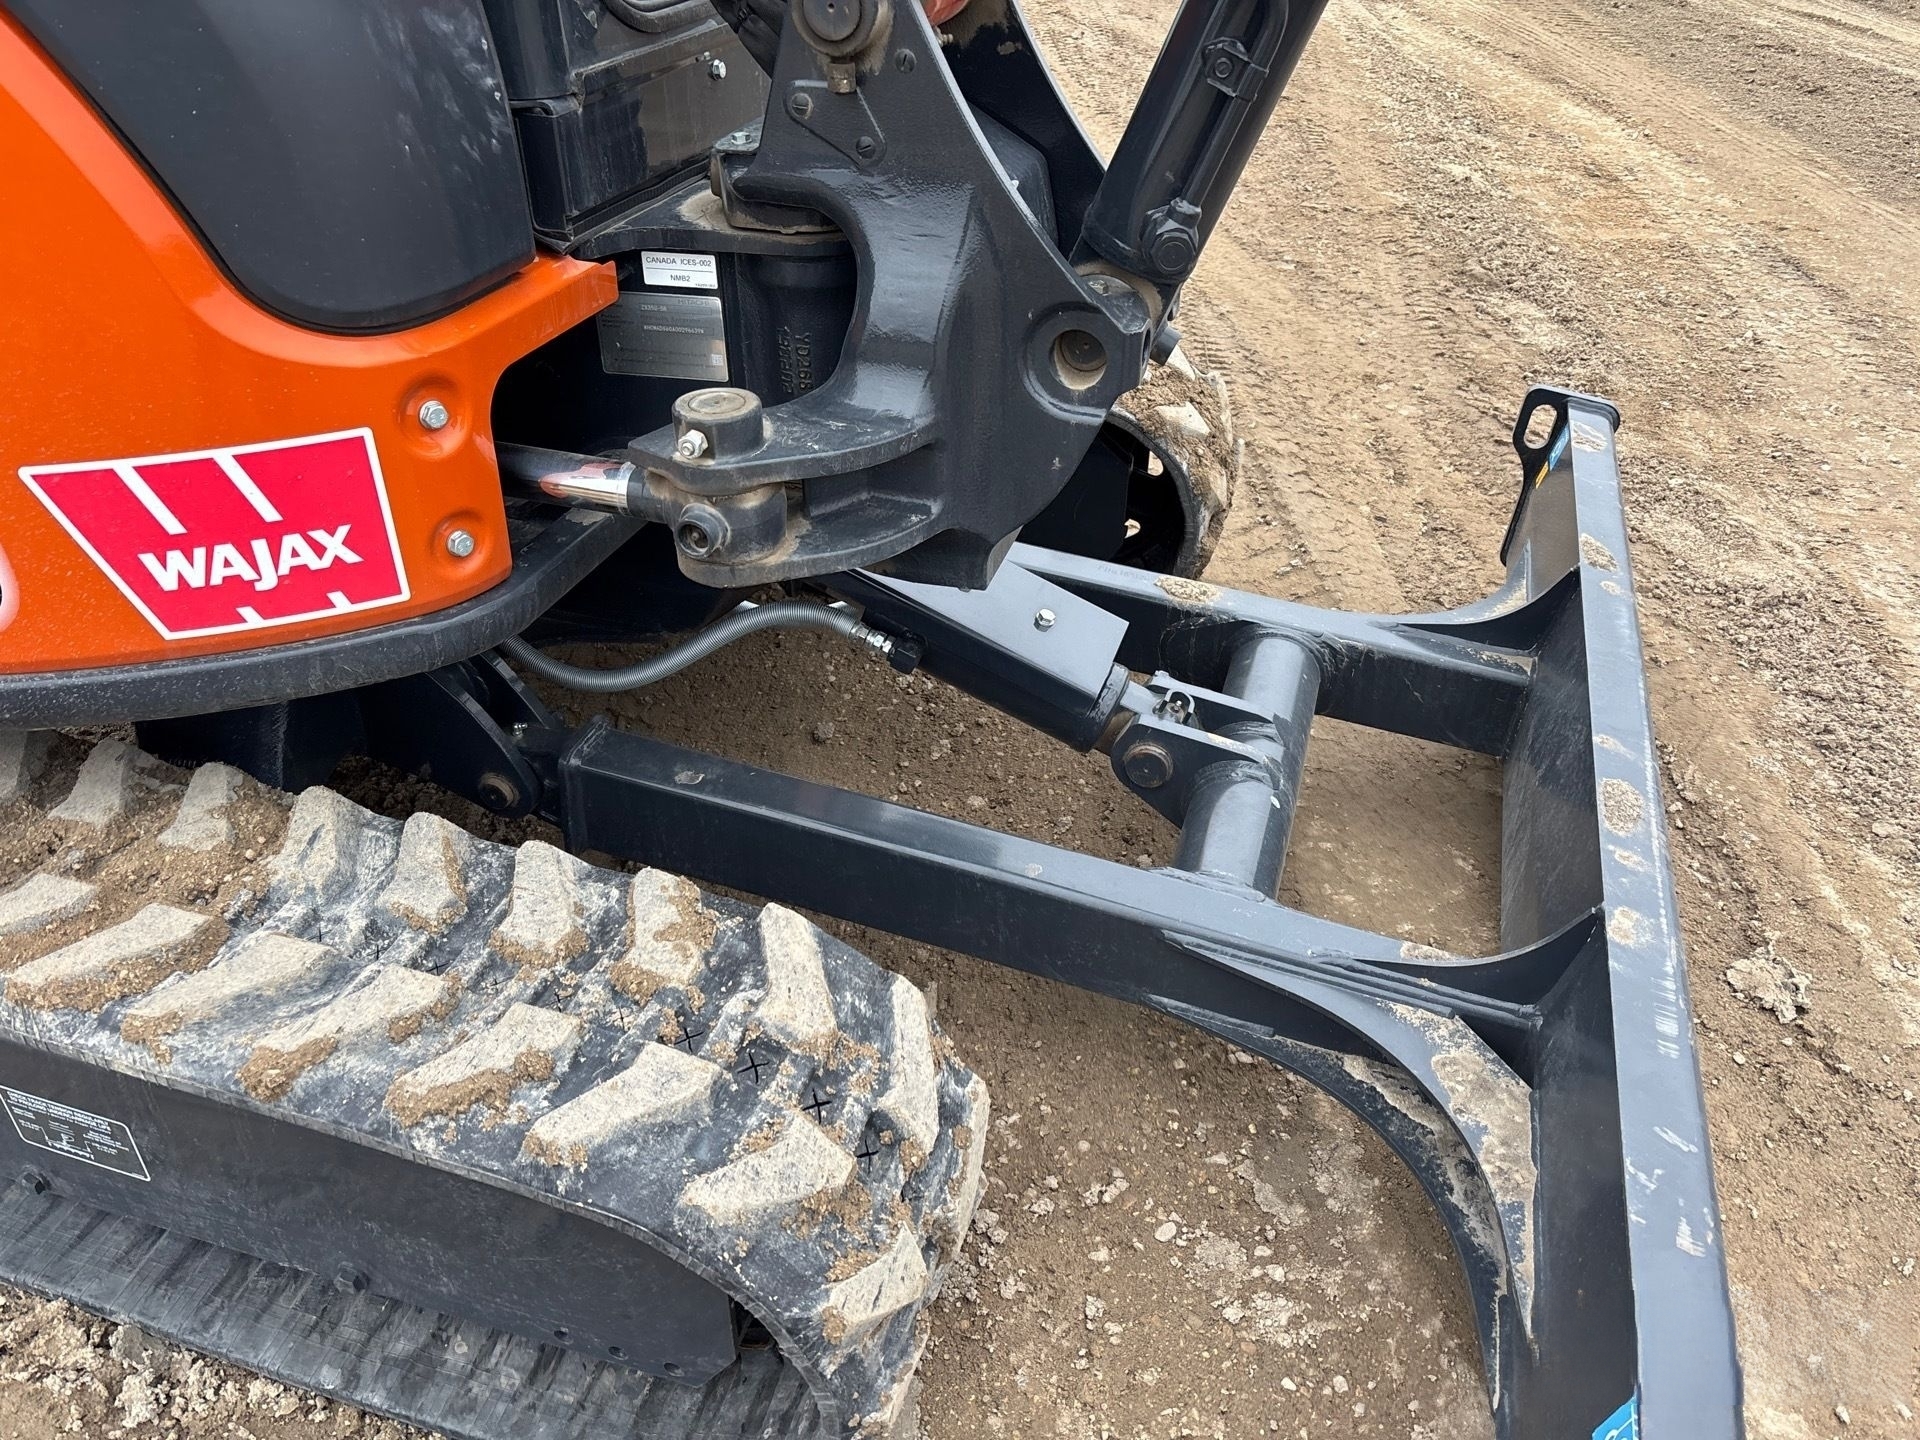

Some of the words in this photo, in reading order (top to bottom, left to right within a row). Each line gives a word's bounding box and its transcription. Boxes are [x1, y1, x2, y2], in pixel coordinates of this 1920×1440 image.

[645, 256, 677, 265] CANADA
[680, 258, 712, 267] ICES-002
[670, 274, 691, 282] NMB2
[138, 523, 364, 592] WAJAX
